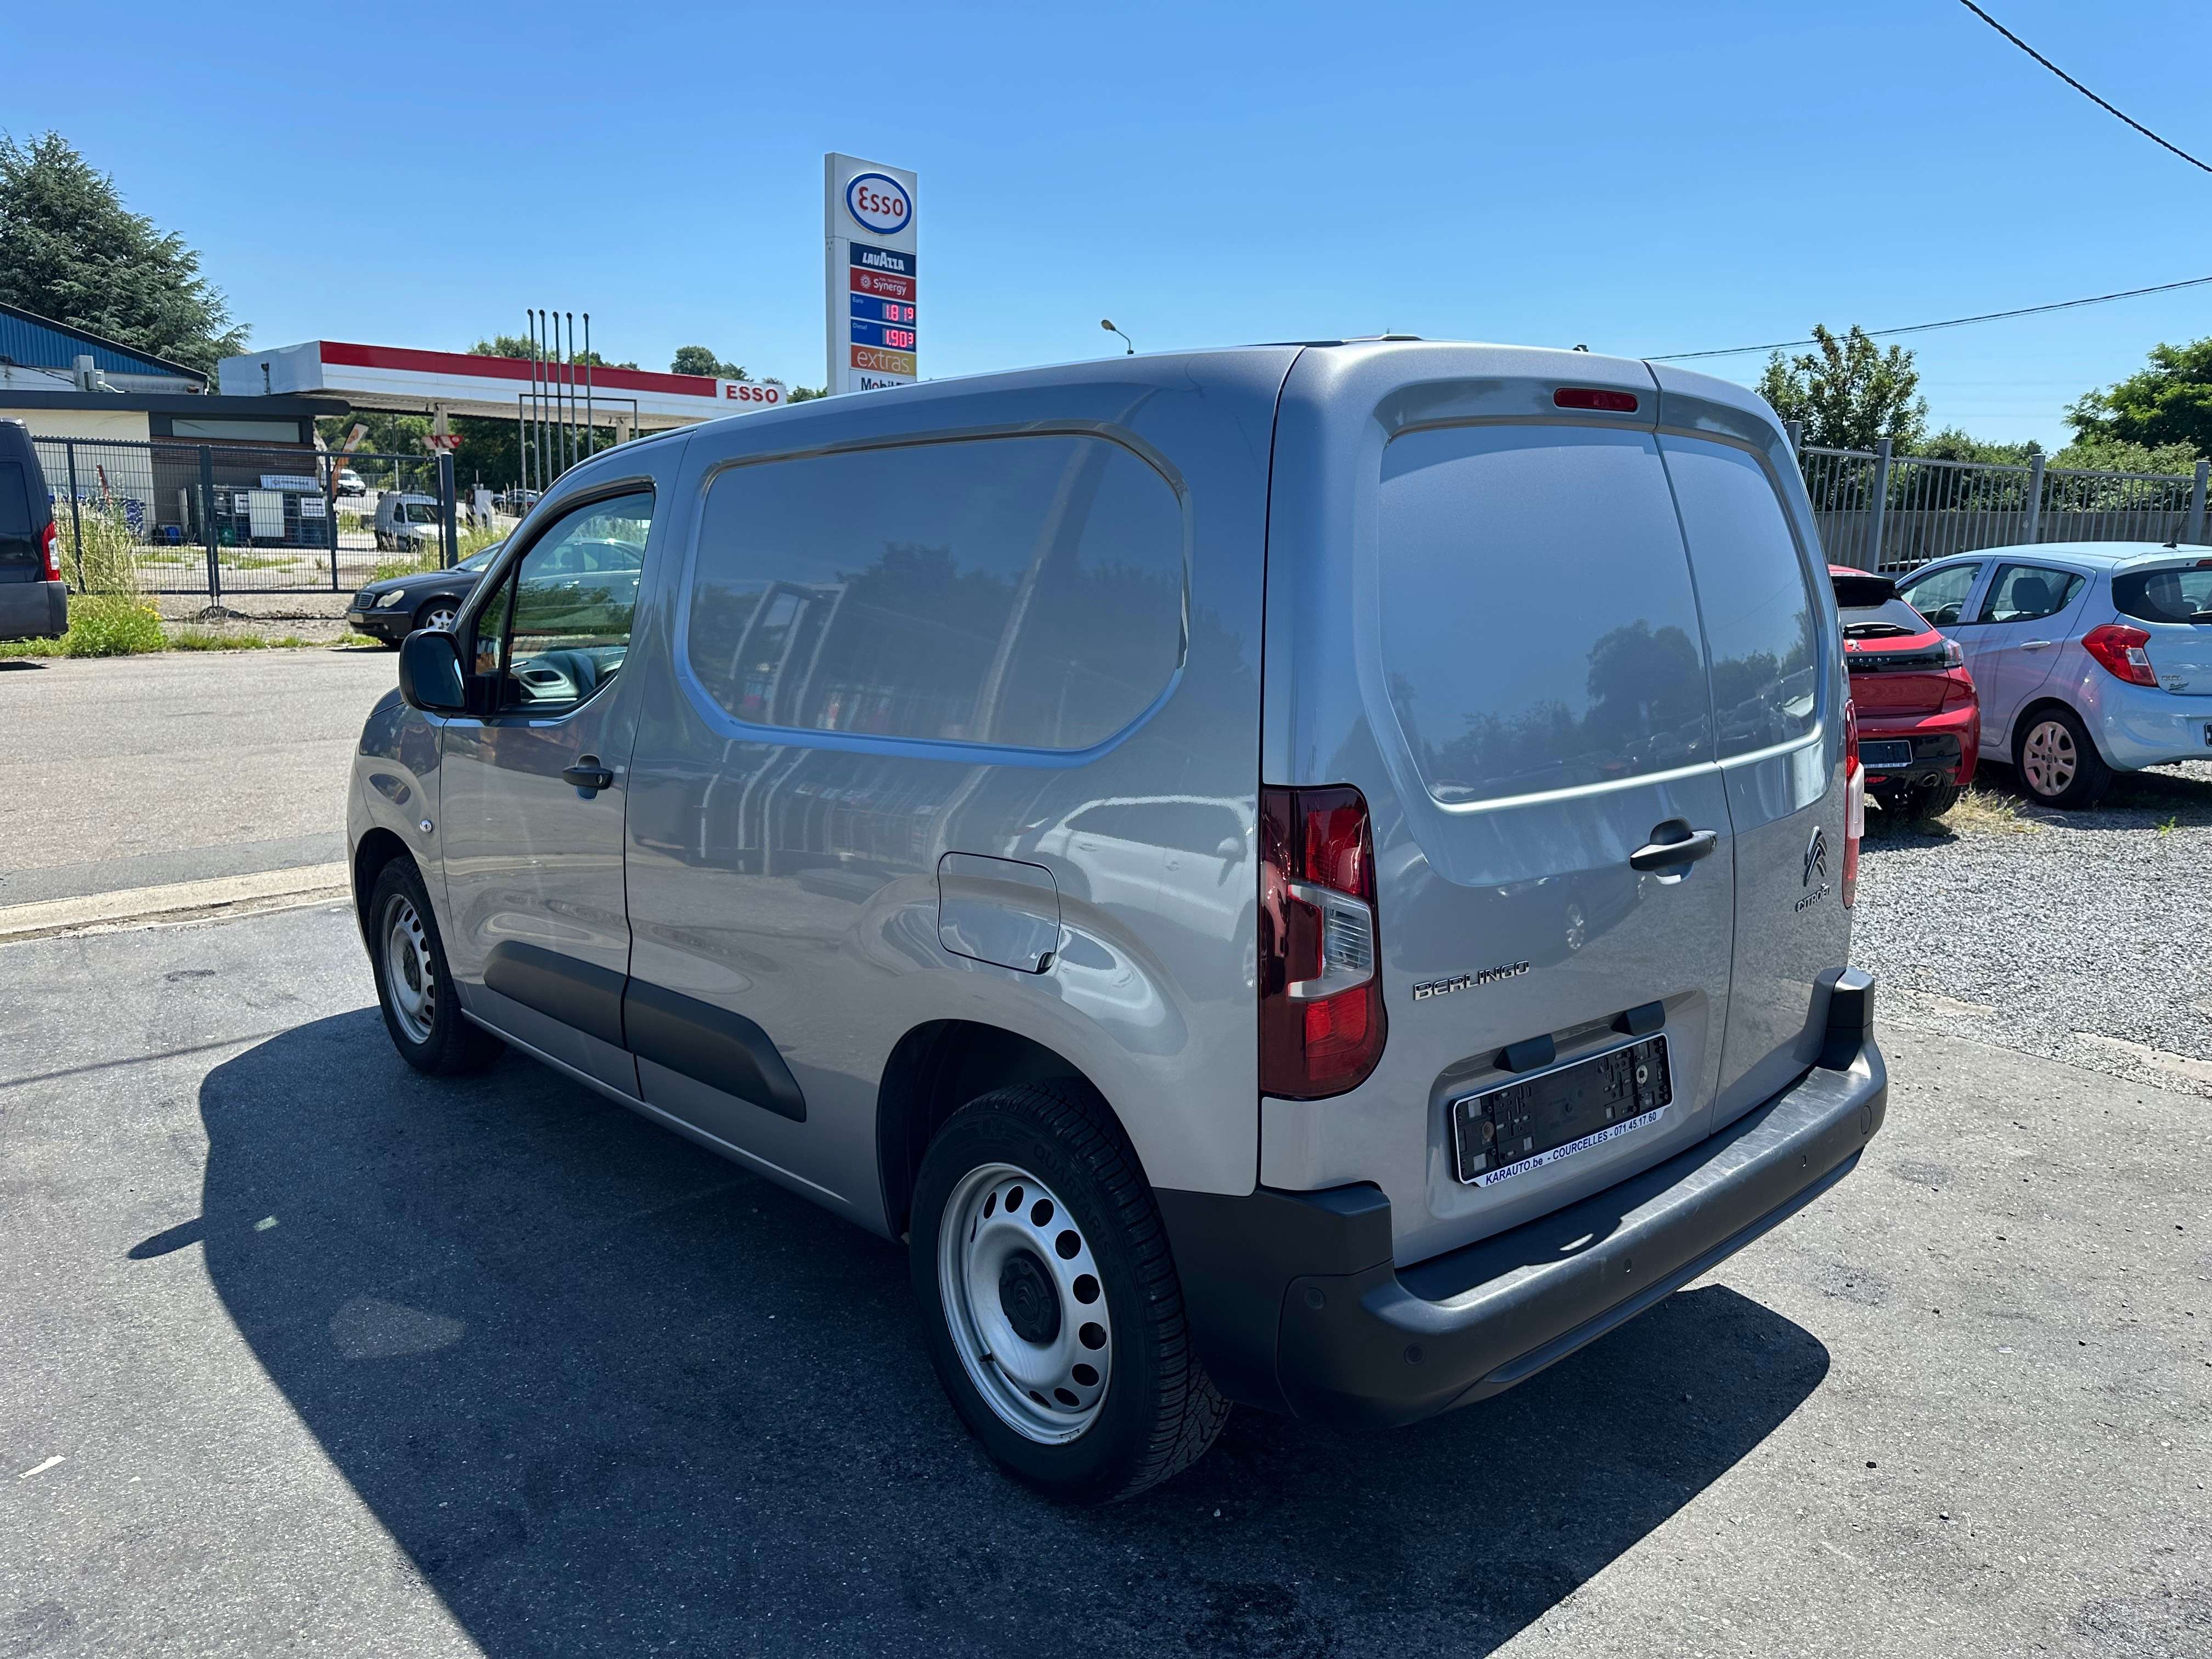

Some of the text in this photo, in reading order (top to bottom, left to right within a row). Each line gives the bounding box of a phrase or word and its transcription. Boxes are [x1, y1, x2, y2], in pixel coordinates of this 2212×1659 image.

[862, 251, 905, 272] LAVAZZA
[873, 278, 907, 296] Synergy
[726, 385, 778, 404] ESSO
[1413, 960, 1530, 1001] BERLINGO
[1486, 1158, 1543, 1186] KARAUTO.be
[1553, 1131, 1608, 1160] COURCELLES
[1614, 1111, 1657, 1137] 071.45.17.60
